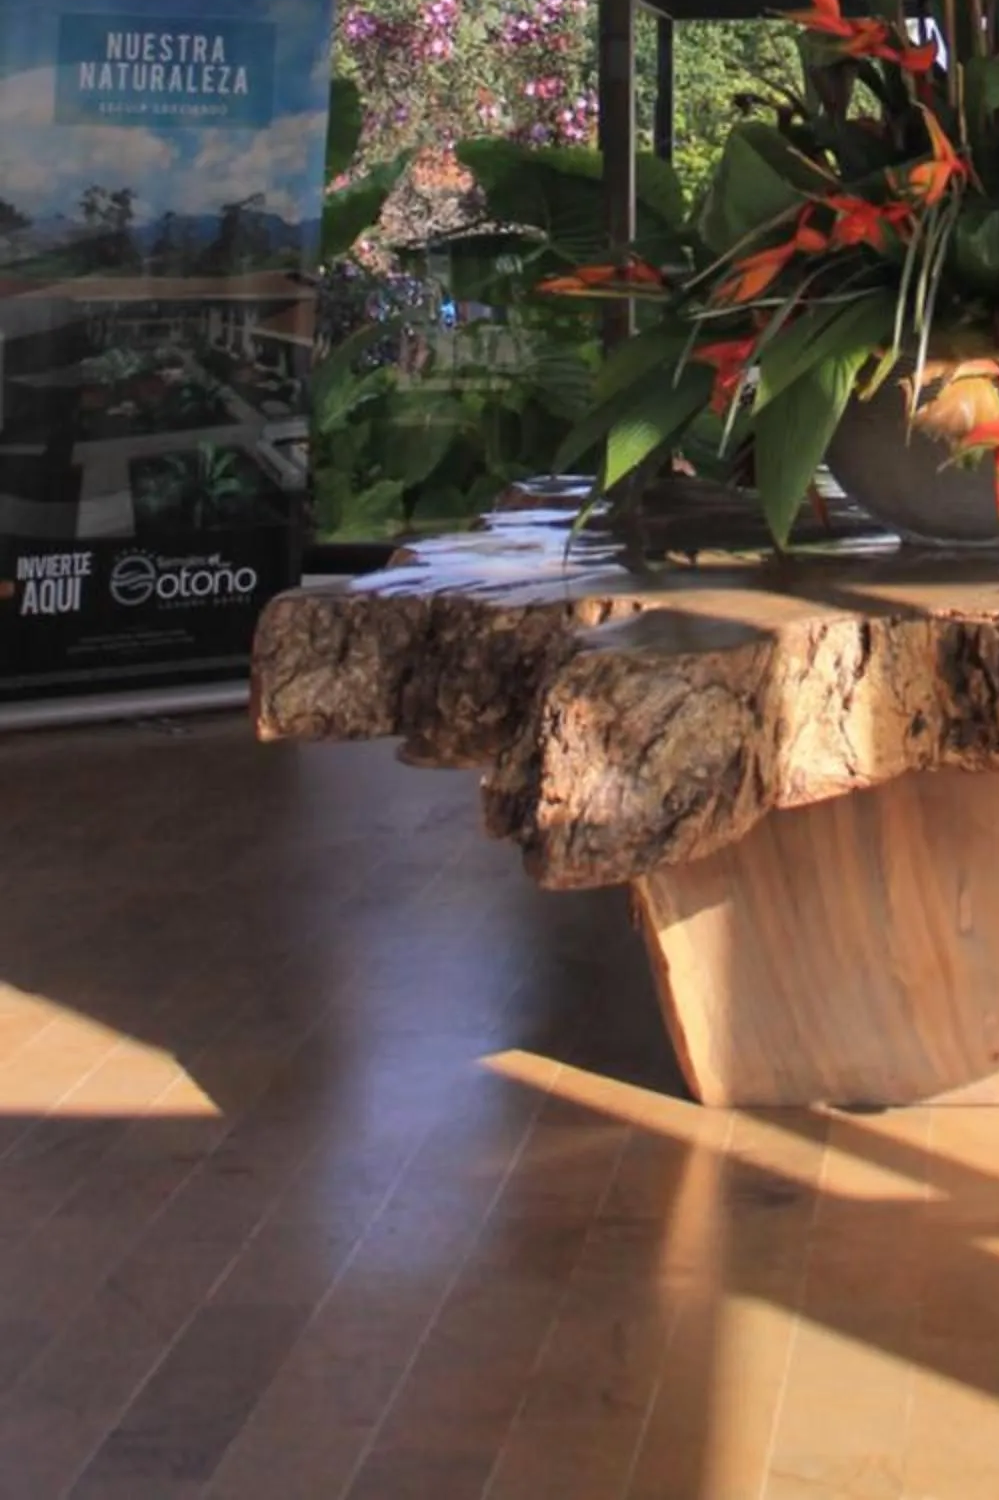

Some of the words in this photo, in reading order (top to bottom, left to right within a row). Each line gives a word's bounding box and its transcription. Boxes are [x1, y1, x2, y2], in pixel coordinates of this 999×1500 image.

[106, 31, 226, 63] NUESTRA
[79, 61, 249, 95] NATURALEZA
[17, 551, 93, 580] INVIERTE
